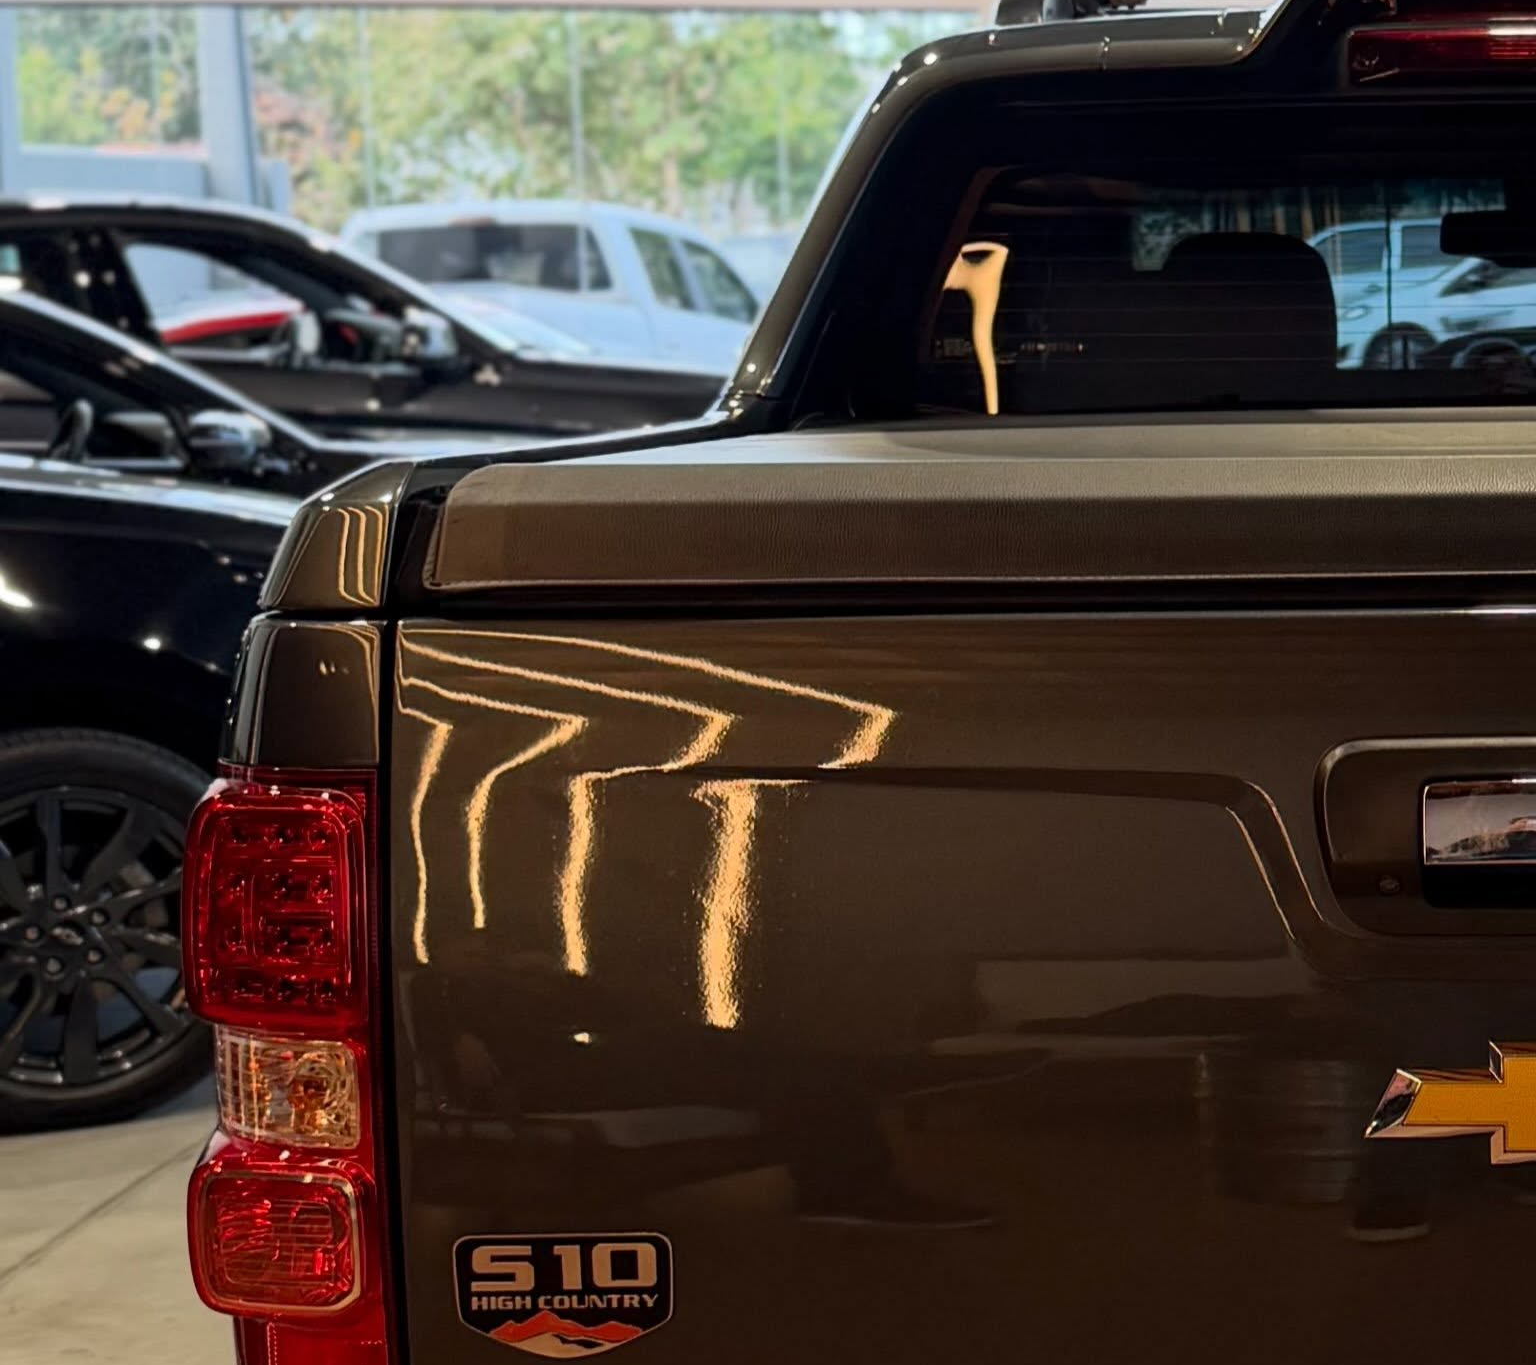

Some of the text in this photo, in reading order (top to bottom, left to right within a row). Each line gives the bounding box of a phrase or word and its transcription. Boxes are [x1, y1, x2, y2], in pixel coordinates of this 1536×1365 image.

[470, 1242, 657, 1292] S10
[470, 1293, 659, 1311] HIGH COUNTRY
